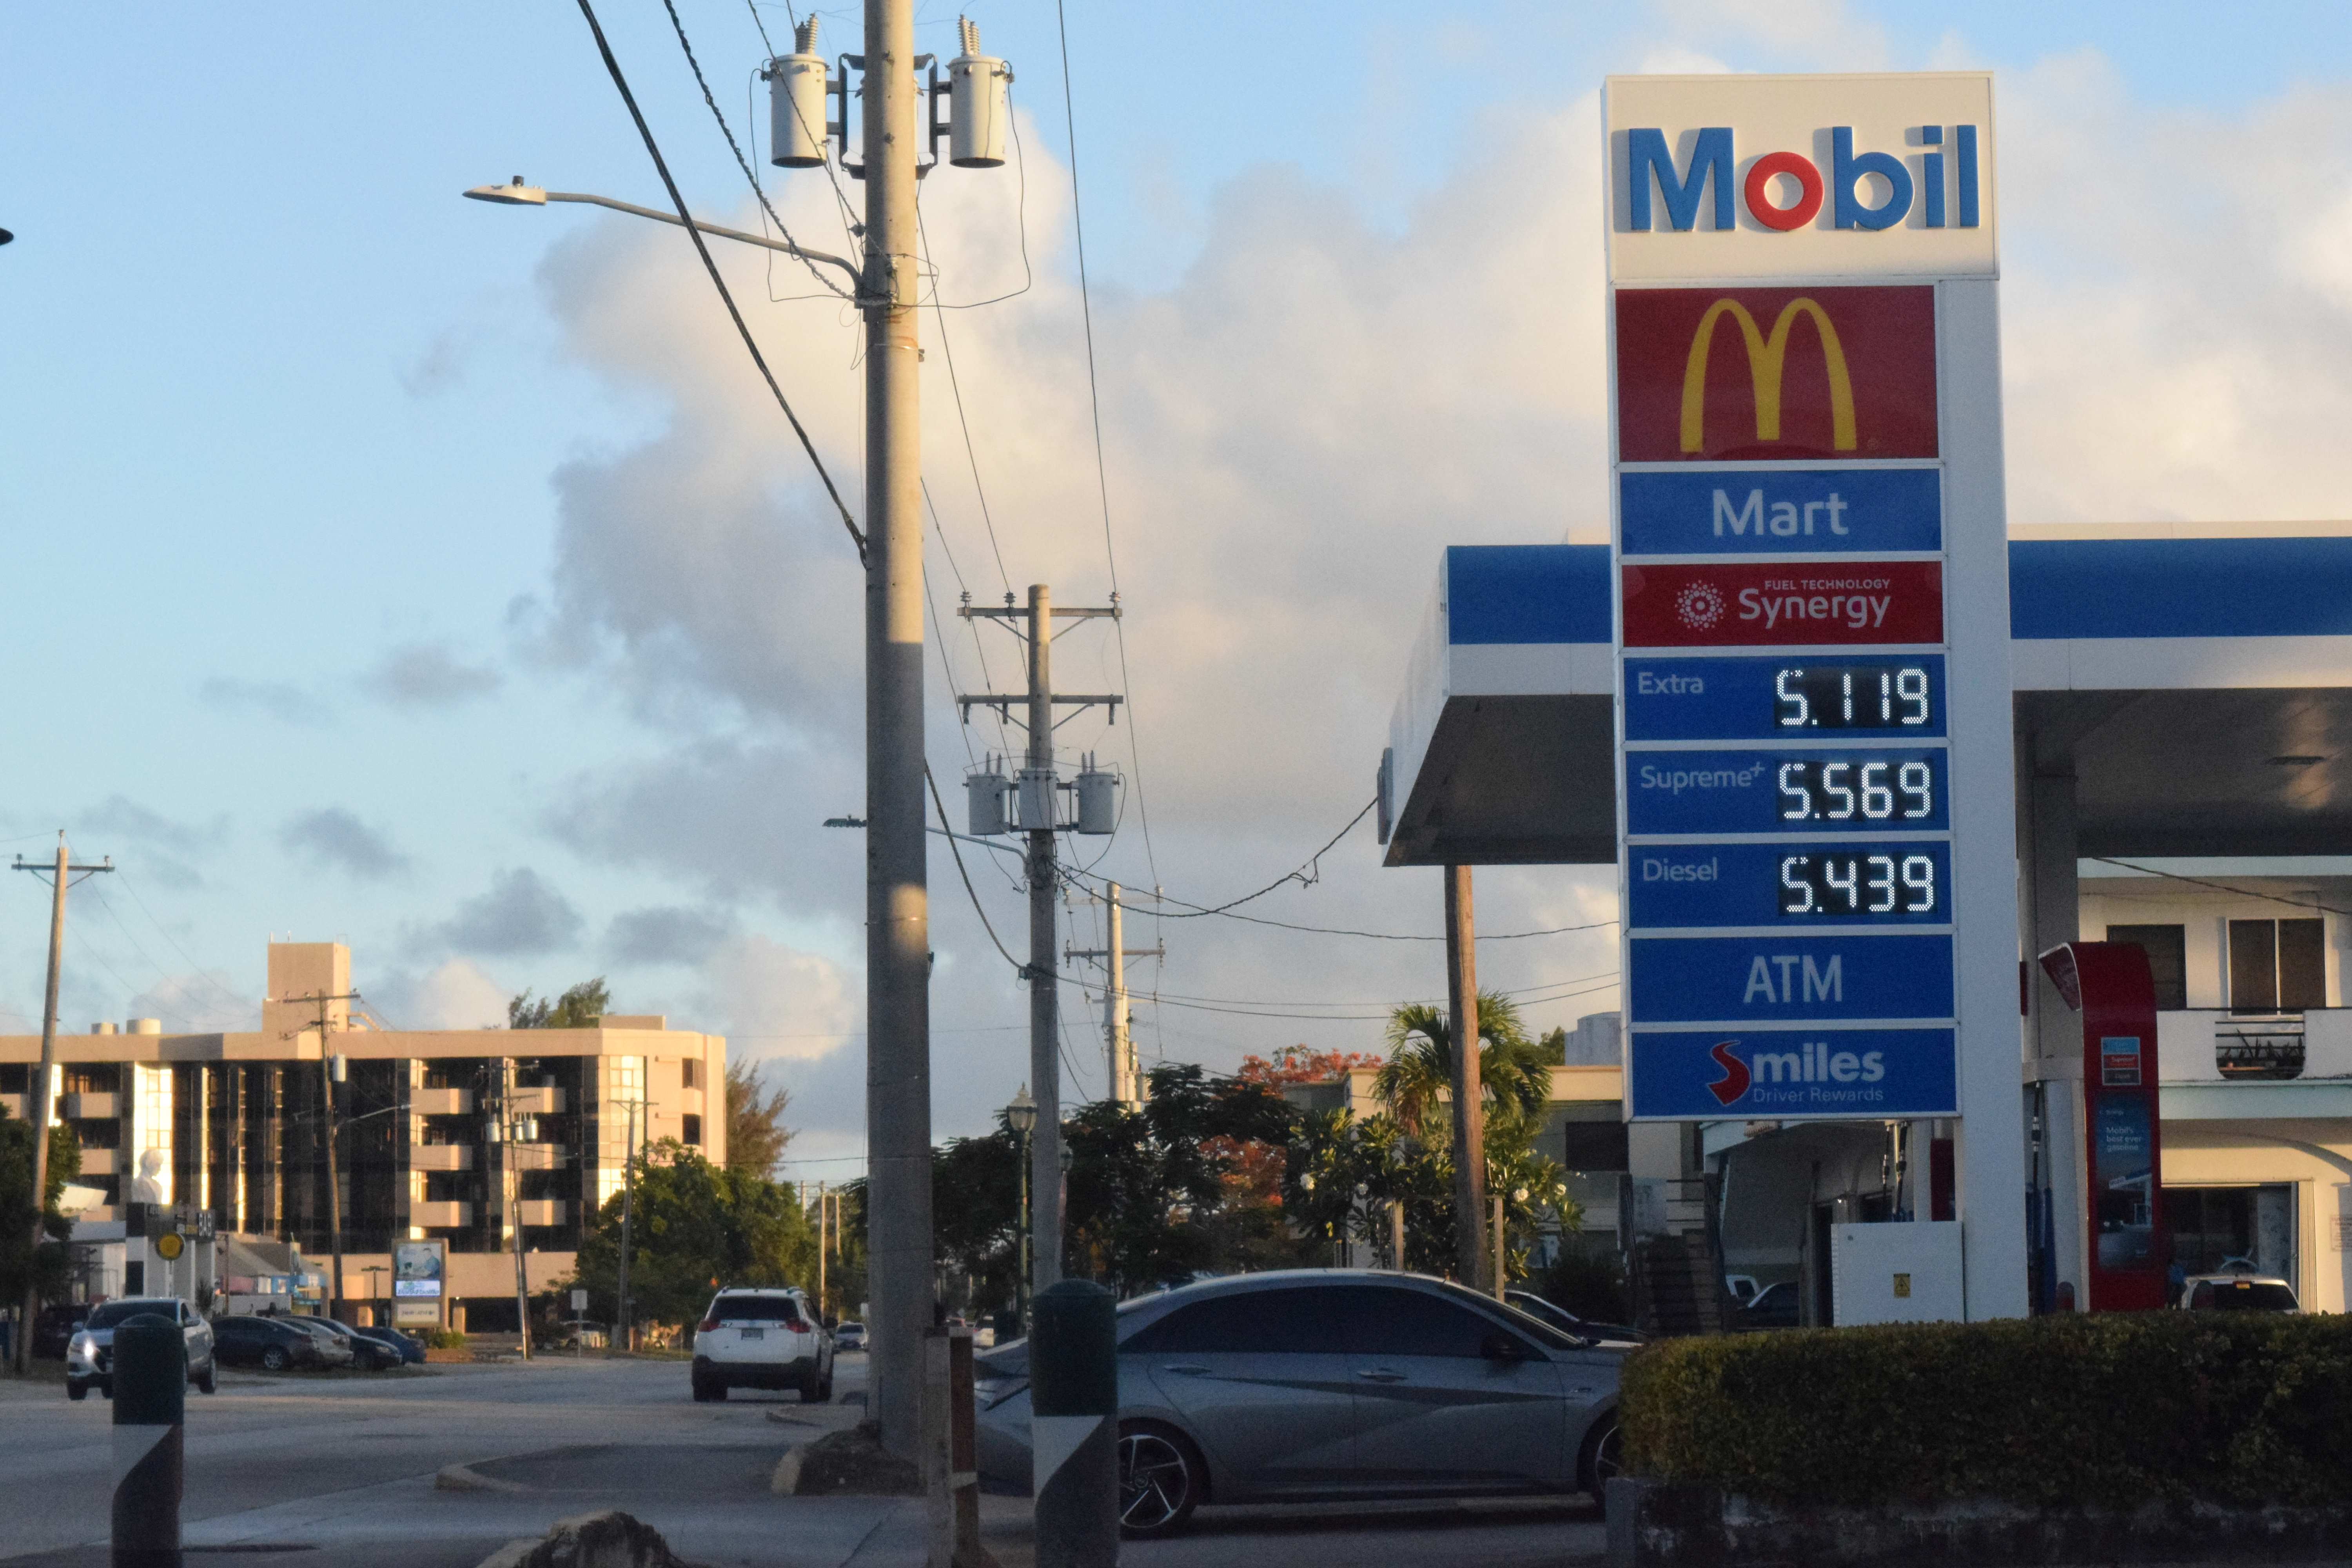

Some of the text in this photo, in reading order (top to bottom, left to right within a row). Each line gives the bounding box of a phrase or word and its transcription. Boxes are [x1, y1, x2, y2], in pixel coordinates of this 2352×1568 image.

[1628, 125, 1980, 232] Mobil
[1713, 488, 1849, 537] Mart
[1739, 588, 1891, 629] Synergy
[1765, 579, 1891, 590] FUEL TECHNOLOGY
[1638, 668, 1929, 726] Extra 5.119
[1779, 762, 1931, 819] 5.569
[1643, 856, 1935, 913] Diesel 5.439
[1743, 955, 1842, 1004] ATM
[1707, 1040, 1885, 1106] Smiles
[1754, 1086, 1883, 1103] Driver Rewards
[2107, 1143, 2139, 1152] gasoline
